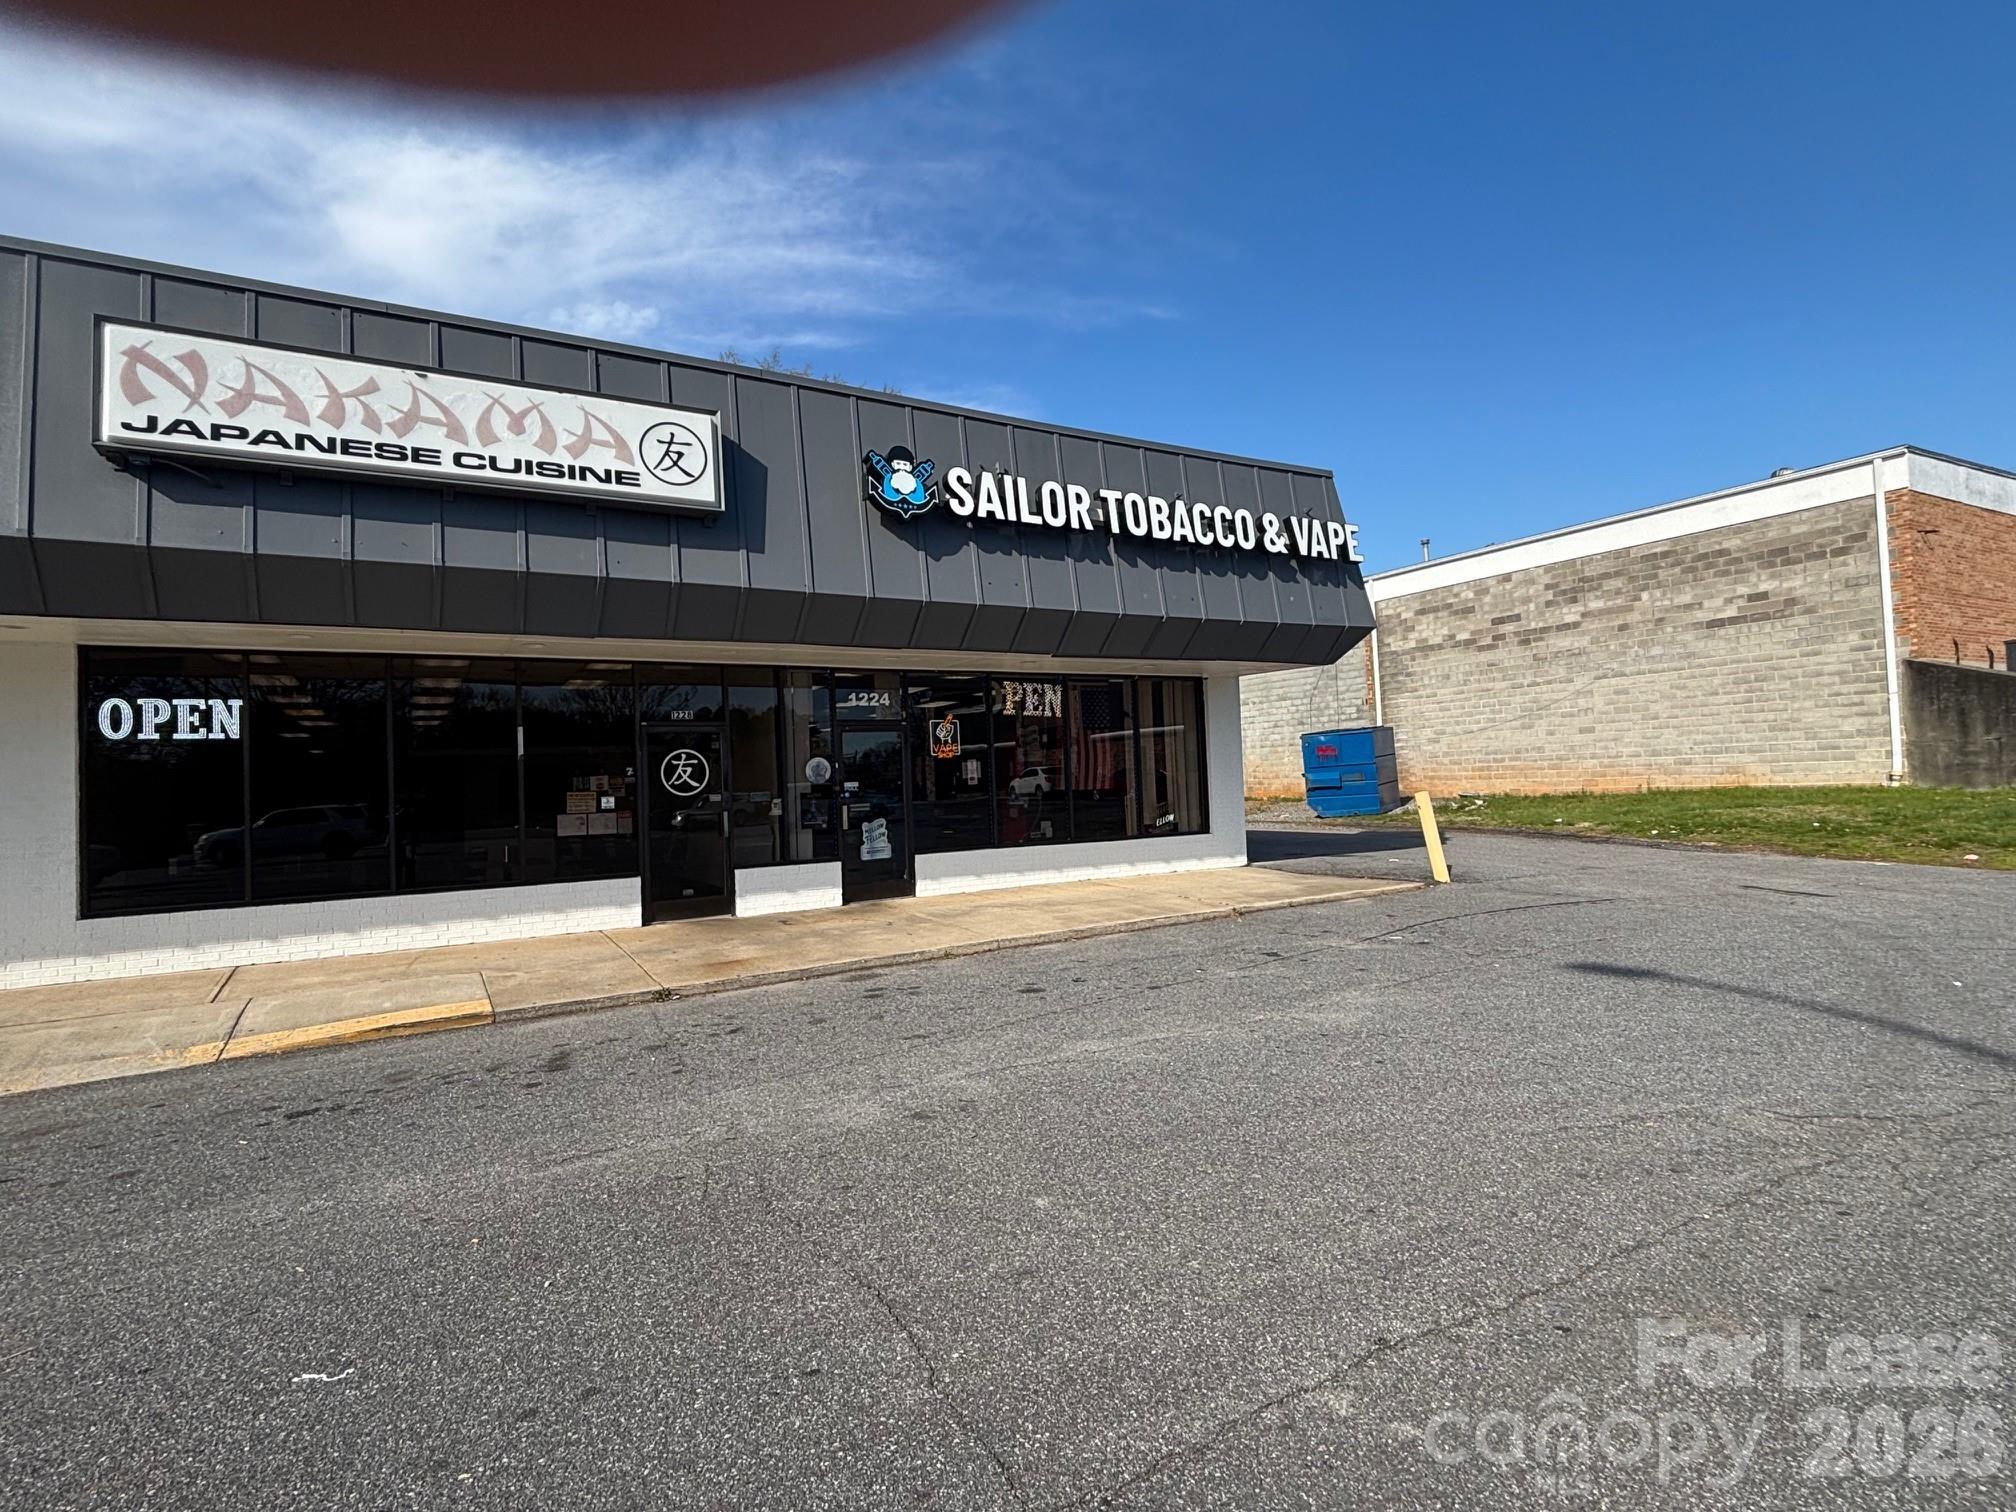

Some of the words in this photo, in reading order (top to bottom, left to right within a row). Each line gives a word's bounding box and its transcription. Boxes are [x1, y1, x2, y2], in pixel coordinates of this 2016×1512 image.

[118, 340, 636, 467] NAKAMA
[120, 414, 442, 467] JAPANESE
[452, 452, 642, 488] CUISINE
[653, 430, 696, 479] 友
[946, 466, 1094, 532] SAILOR
[1098, 488, 1256, 550] TOBACCO
[1263, 513, 1289, 554] &
[1289, 516, 1365, 564] VAPE
[98, 697, 243, 740] OPEN
[848, 692, 890, 707] 1224
[668, 753, 701, 787] 友
[932, 743, 958, 753] VAPE
